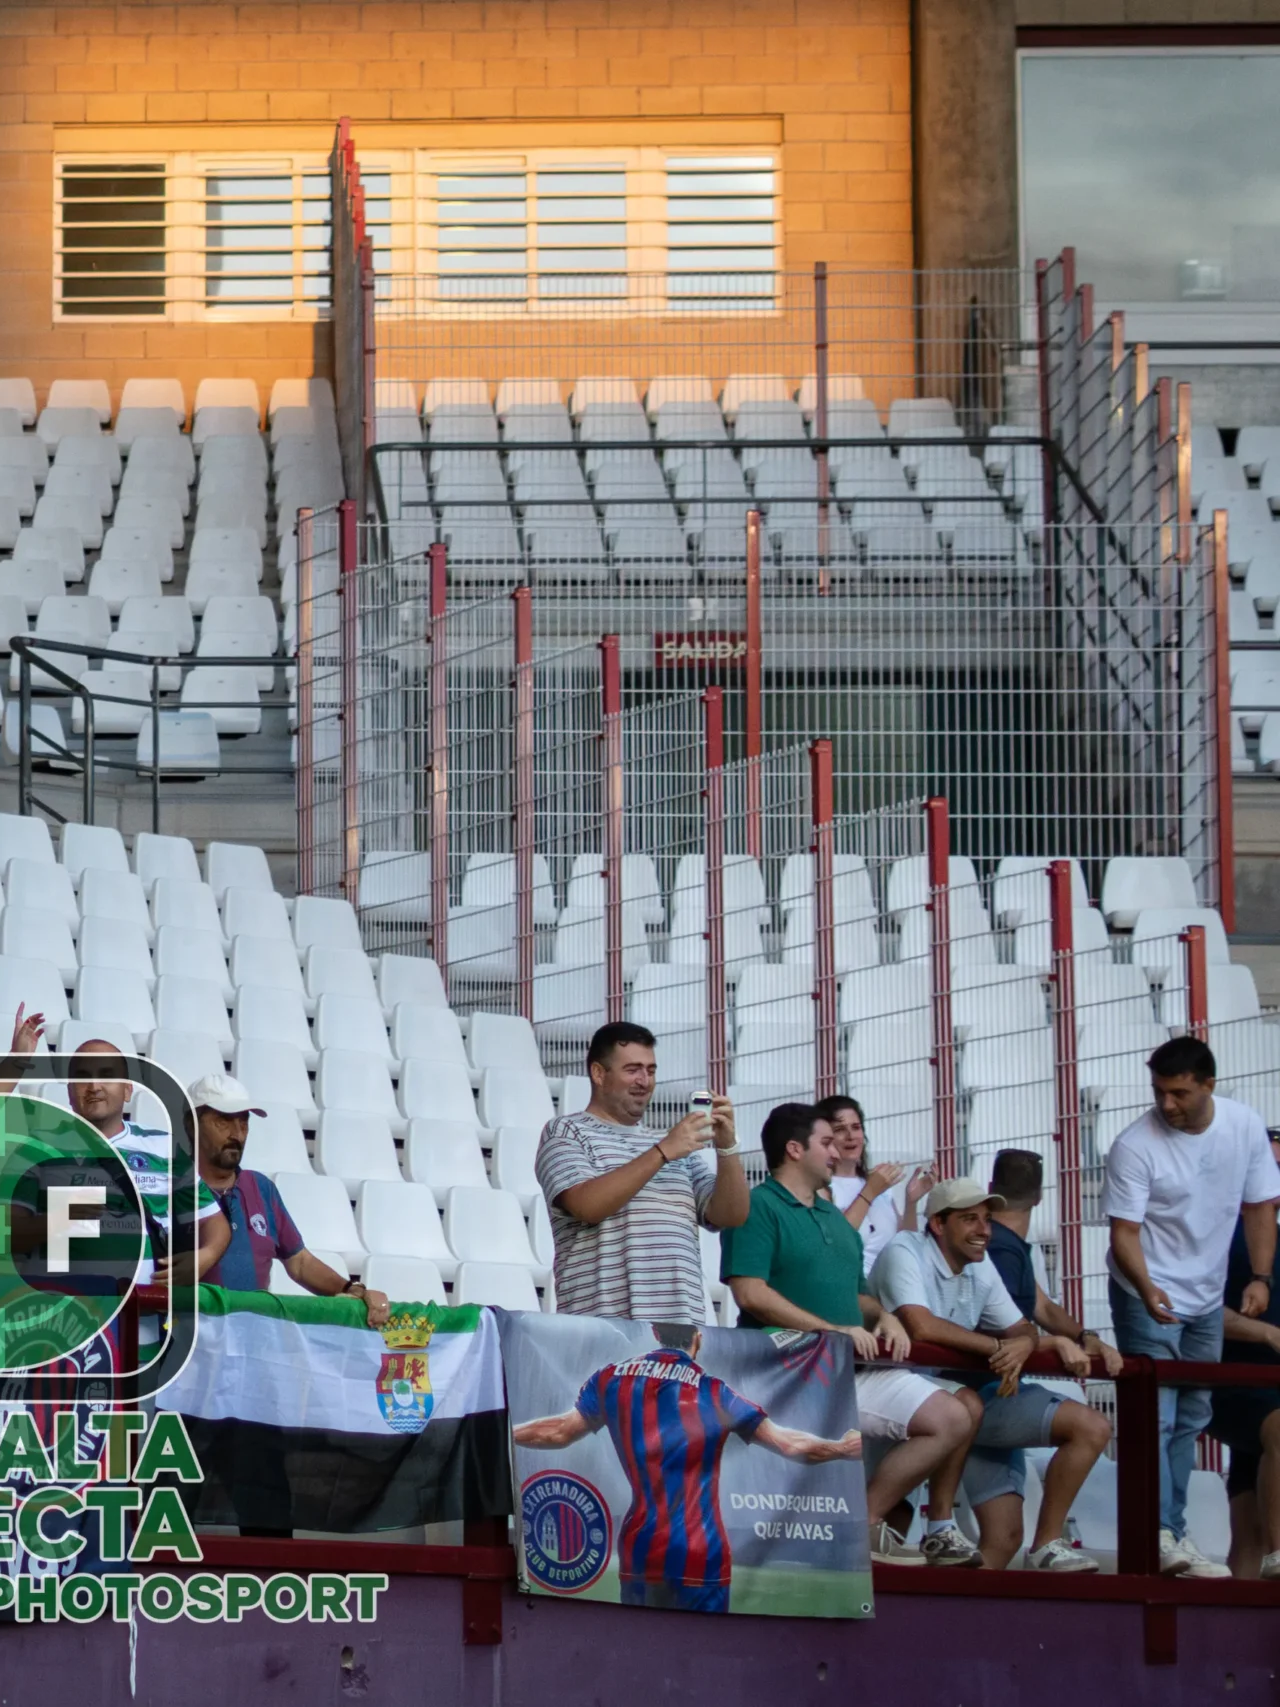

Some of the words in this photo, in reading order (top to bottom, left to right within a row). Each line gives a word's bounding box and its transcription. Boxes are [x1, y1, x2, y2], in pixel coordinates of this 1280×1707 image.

[662, 641, 747, 660] SALIDA
[613, 1357, 702, 1389] EXTREMADURA
[523, 1480, 600, 1524] EXTREMADURA
[729, 1492, 850, 1514] DONDEQUIERA
[753, 1521, 783, 1539] QUE
[784, 1522, 835, 1541] VAYAS
[524, 1541, 547, 1572] CLUB
[547, 1548, 600, 1582] DEPORTIVO
